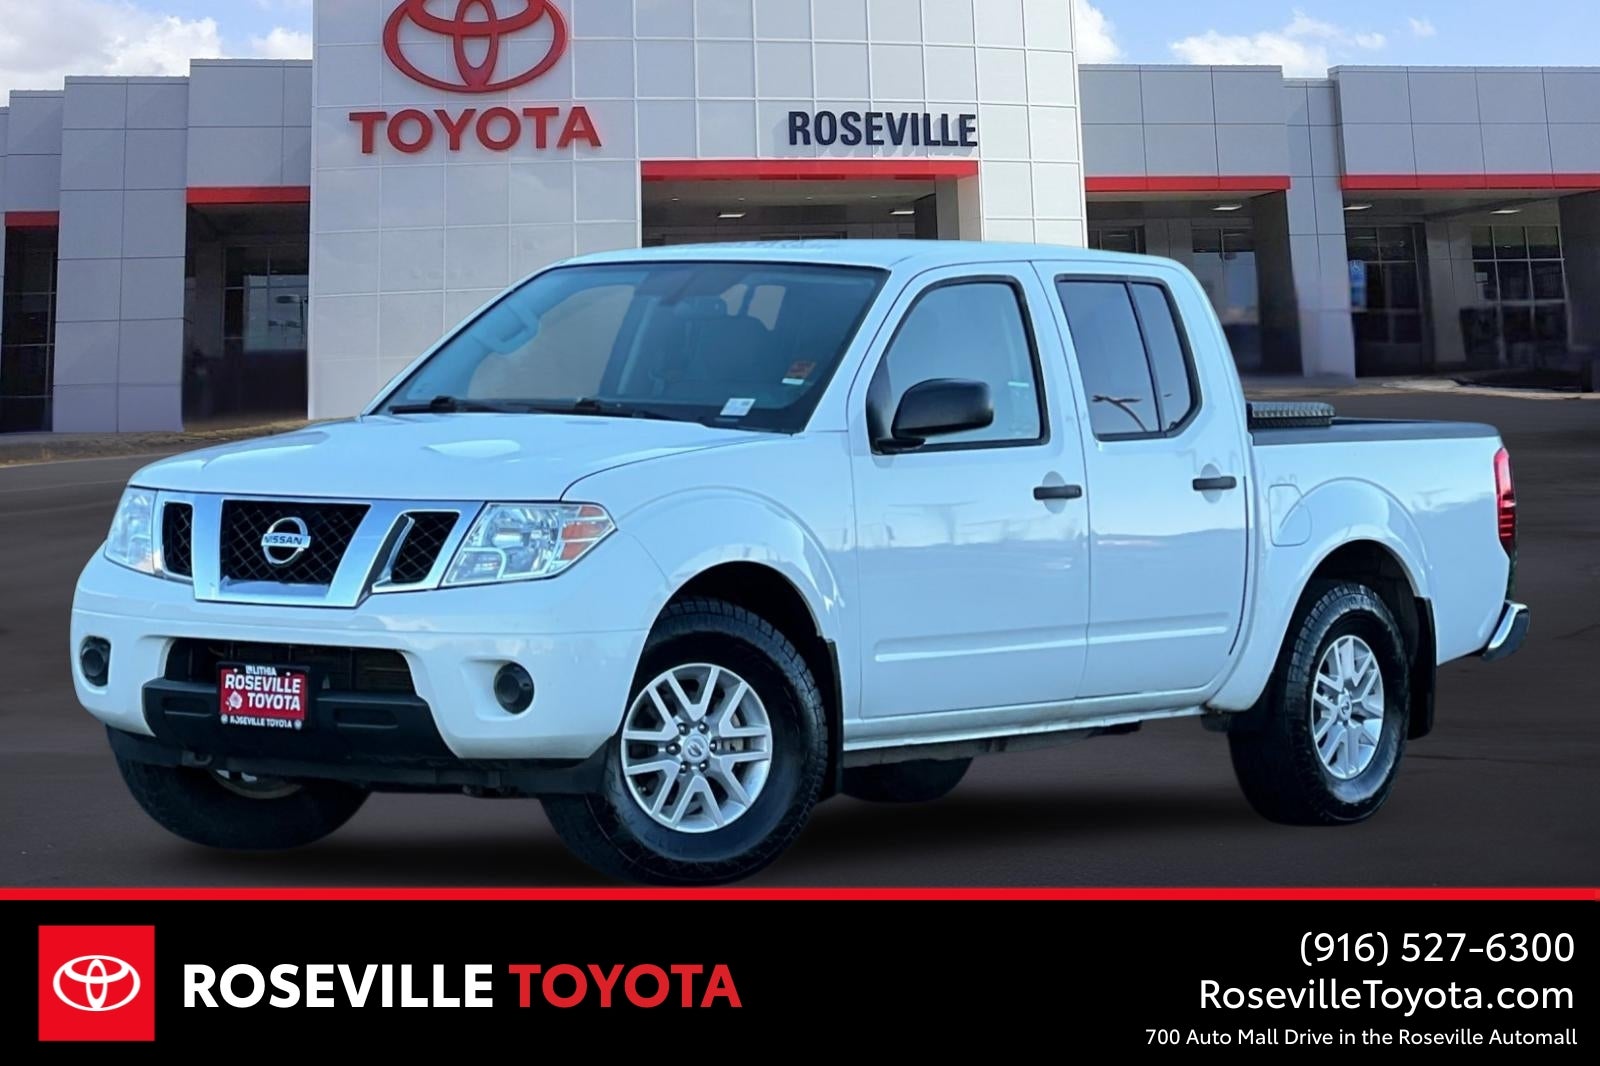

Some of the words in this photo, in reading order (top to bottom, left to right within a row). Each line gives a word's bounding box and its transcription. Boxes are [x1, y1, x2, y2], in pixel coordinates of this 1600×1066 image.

[349, 106, 602, 154] TOYOTA
[788, 110, 979, 147] ROSEVILLE
[264, 535, 303, 545] NISSAN
[224, 674, 301, 694] ROSEVILLE
[247, 692, 301, 711] TOYOTA
[229, 715, 265, 726] ROSEVILLE
[266, 718, 293, 728] TOYOTA
